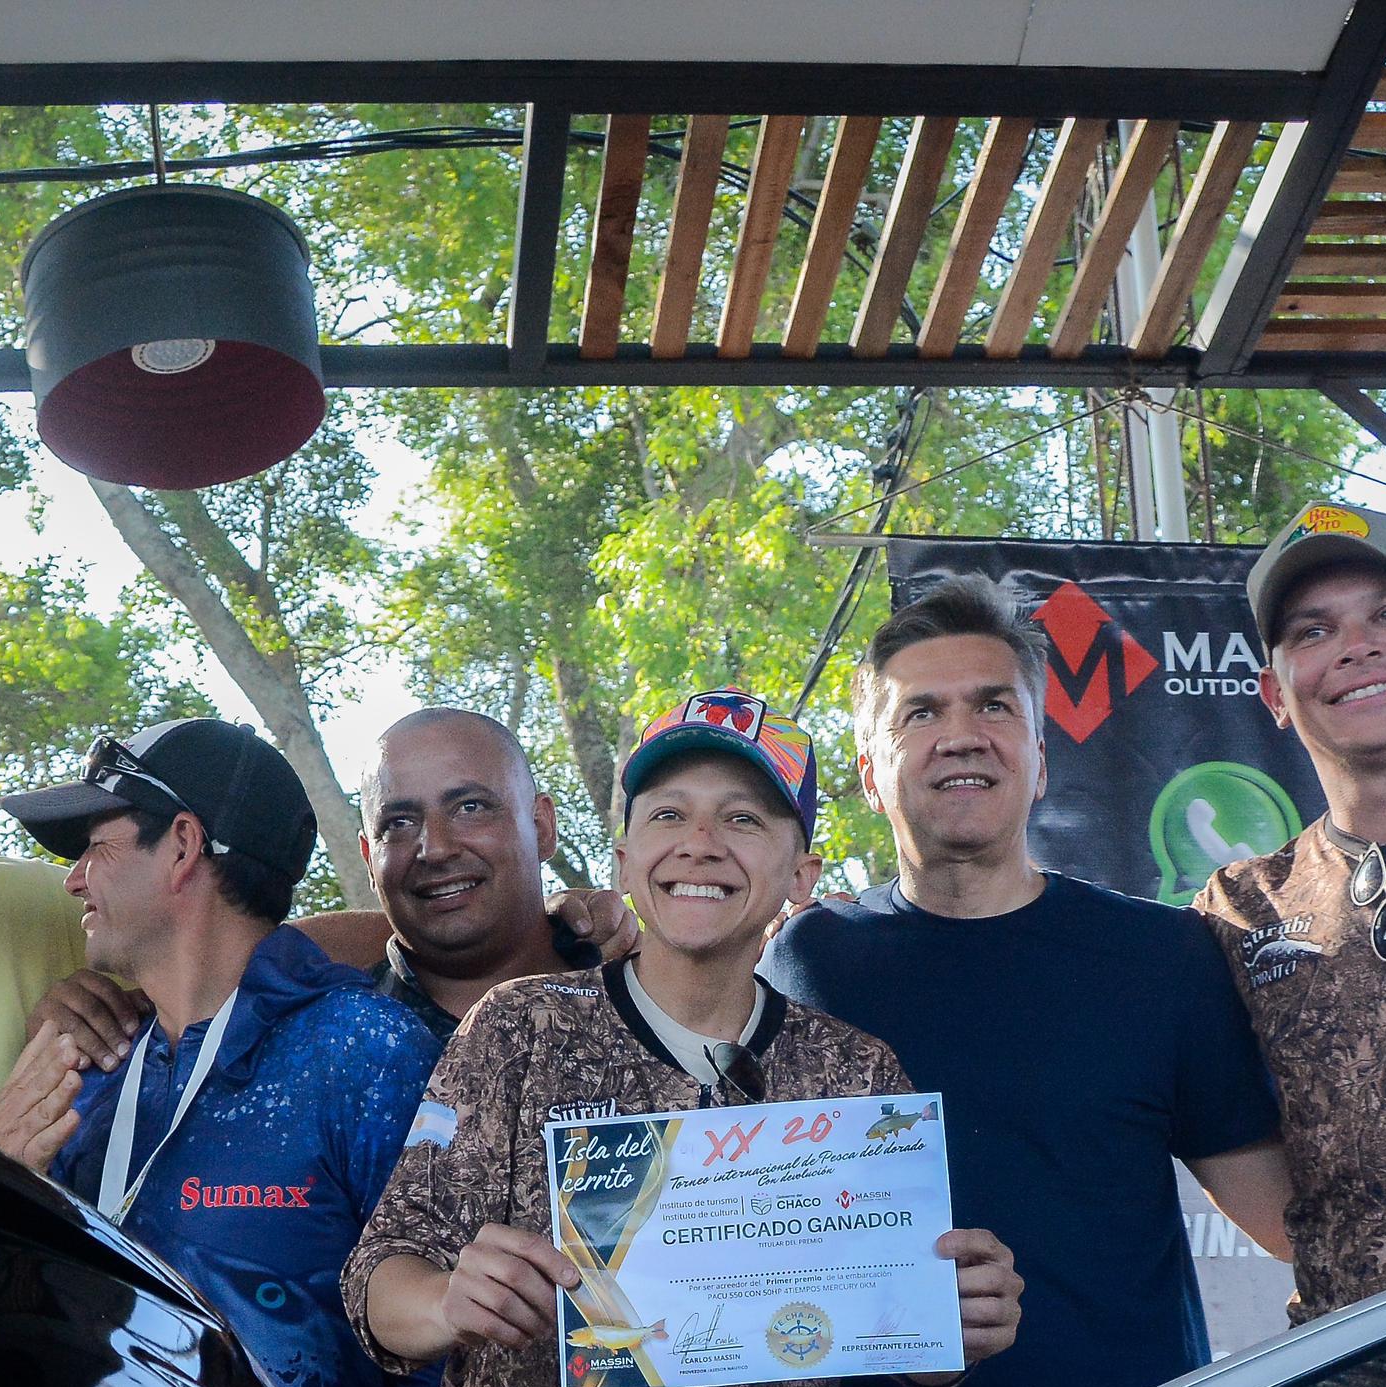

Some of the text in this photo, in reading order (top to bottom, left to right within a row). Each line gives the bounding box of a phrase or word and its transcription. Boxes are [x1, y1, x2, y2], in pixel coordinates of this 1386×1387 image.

[1309, 507, 1348, 523] Bass
[1314, 519, 1341, 532] Pro
[1164, 678, 1261, 696] OUTDO
[558, 1132, 653, 1164] Isla del
[702, 1117, 767, 1168] XX
[670, 1138, 927, 1190] Torneo internacional de Pesca del dorado
[562, 1163, 636, 1193] cerrito
[758, 1165, 836, 1187] Con devolución
[180, 1177, 311, 1211] Sumax
[706, 1197, 739, 1206] turismo
[855, 1191, 892, 1200] MASSIN
[776, 1197, 821, 1211] CHACO
[710, 1209, 739, 1218] cultura
[663, 1211, 913, 1245] CERTIFICADO GANADOR
[758, 1237, 824, 1248] TITULAR DEL PREMIO
[750, 1279, 761, 1287] del
[766, 1278, 792, 1286] Primer
[794, 1275, 822, 1284] premio
[708, 1292, 728, 1300] PACU
[730, 1291, 743, 1299] 550
[745, 1290, 761, 1298] CON
[763, 1288, 782, 1296] 50HP
[823, 1283, 858, 1292] MERCURY
[841, 1342, 902, 1352] REPRESENTANTE
[590, 1356, 634, 1367] MASSIN
[685, 1353, 741, 1364] CARLOS MASSIN
